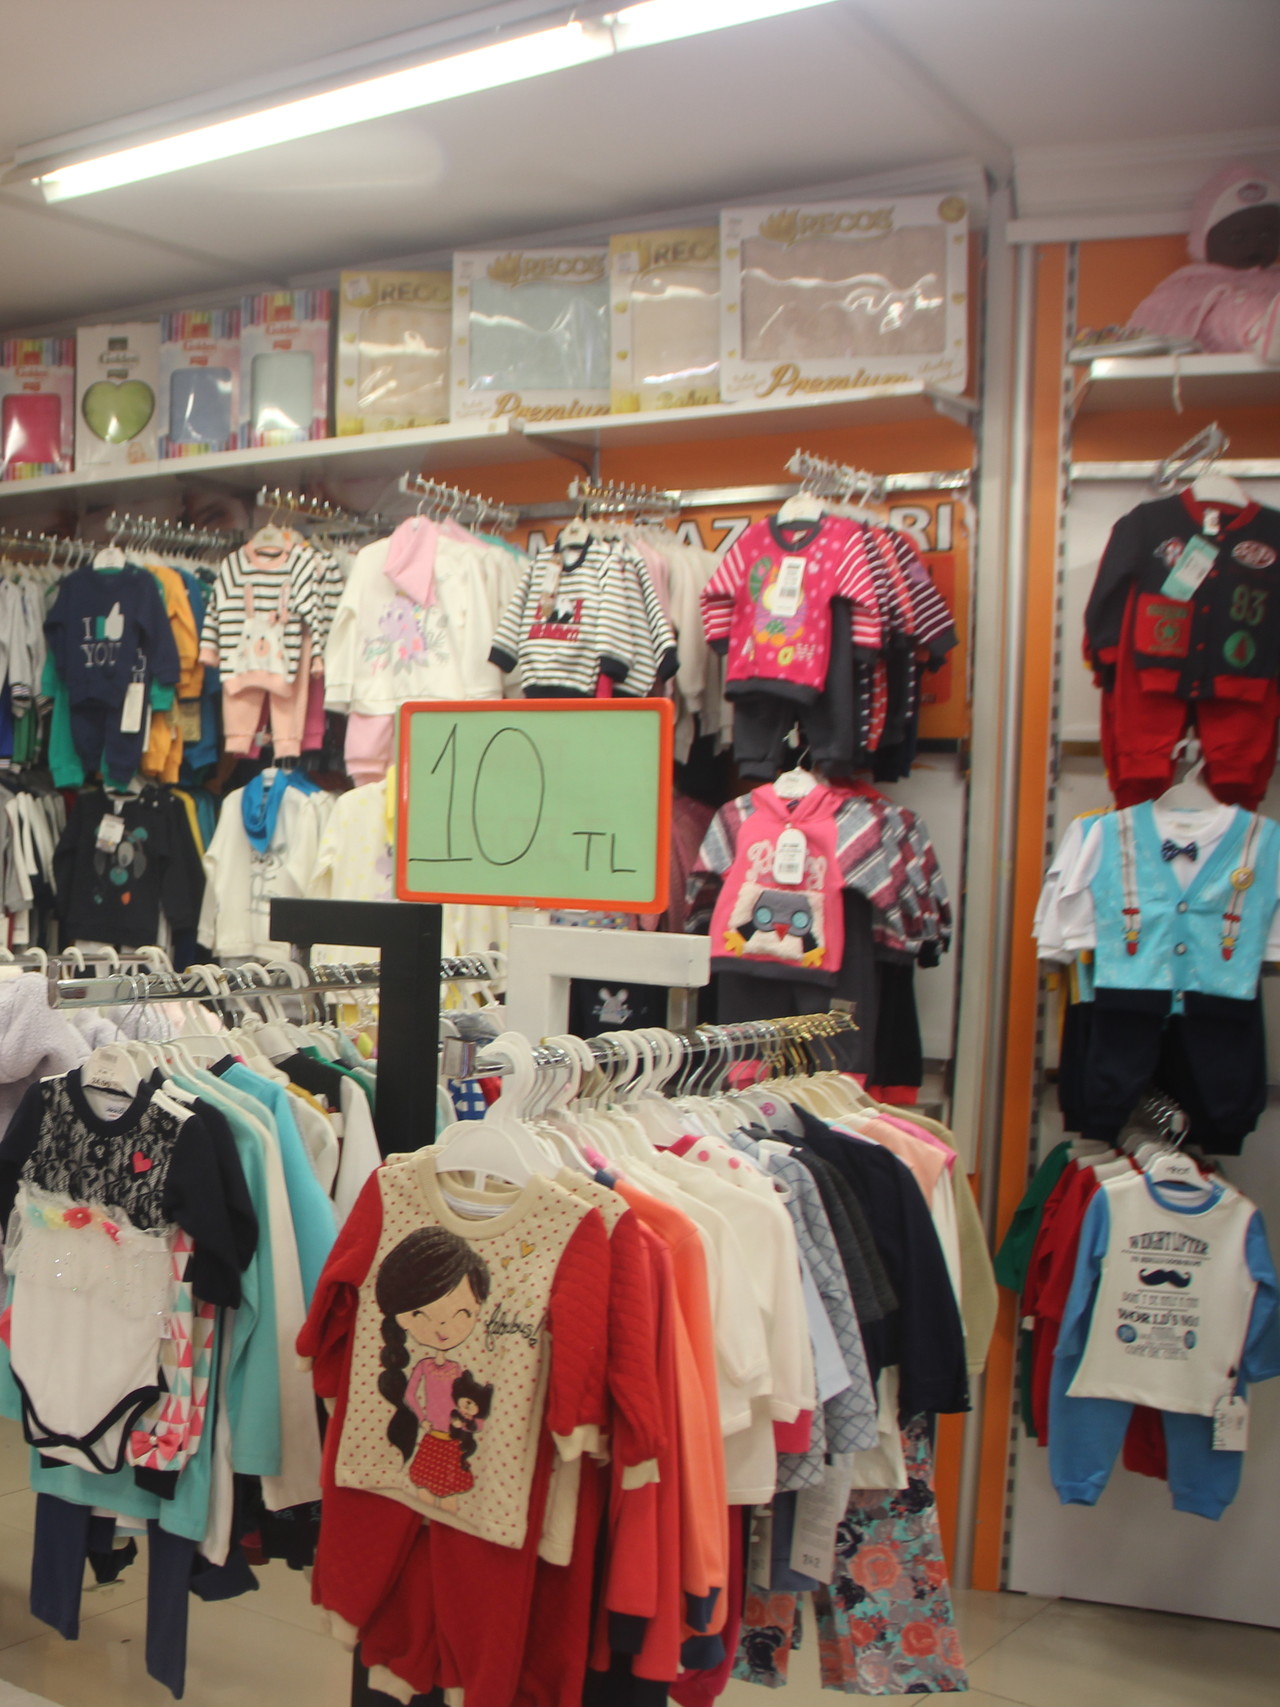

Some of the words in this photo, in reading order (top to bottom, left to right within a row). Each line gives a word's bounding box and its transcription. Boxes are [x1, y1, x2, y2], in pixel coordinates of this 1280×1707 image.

[799, 206, 896, 235] RECOS
[523, 252, 607, 276] RECOS
[756, 362, 915, 399] Premium
[80, 642, 122, 668] YOU
[408, 722, 546, 866] 10
[571, 831, 638, 874] TL
